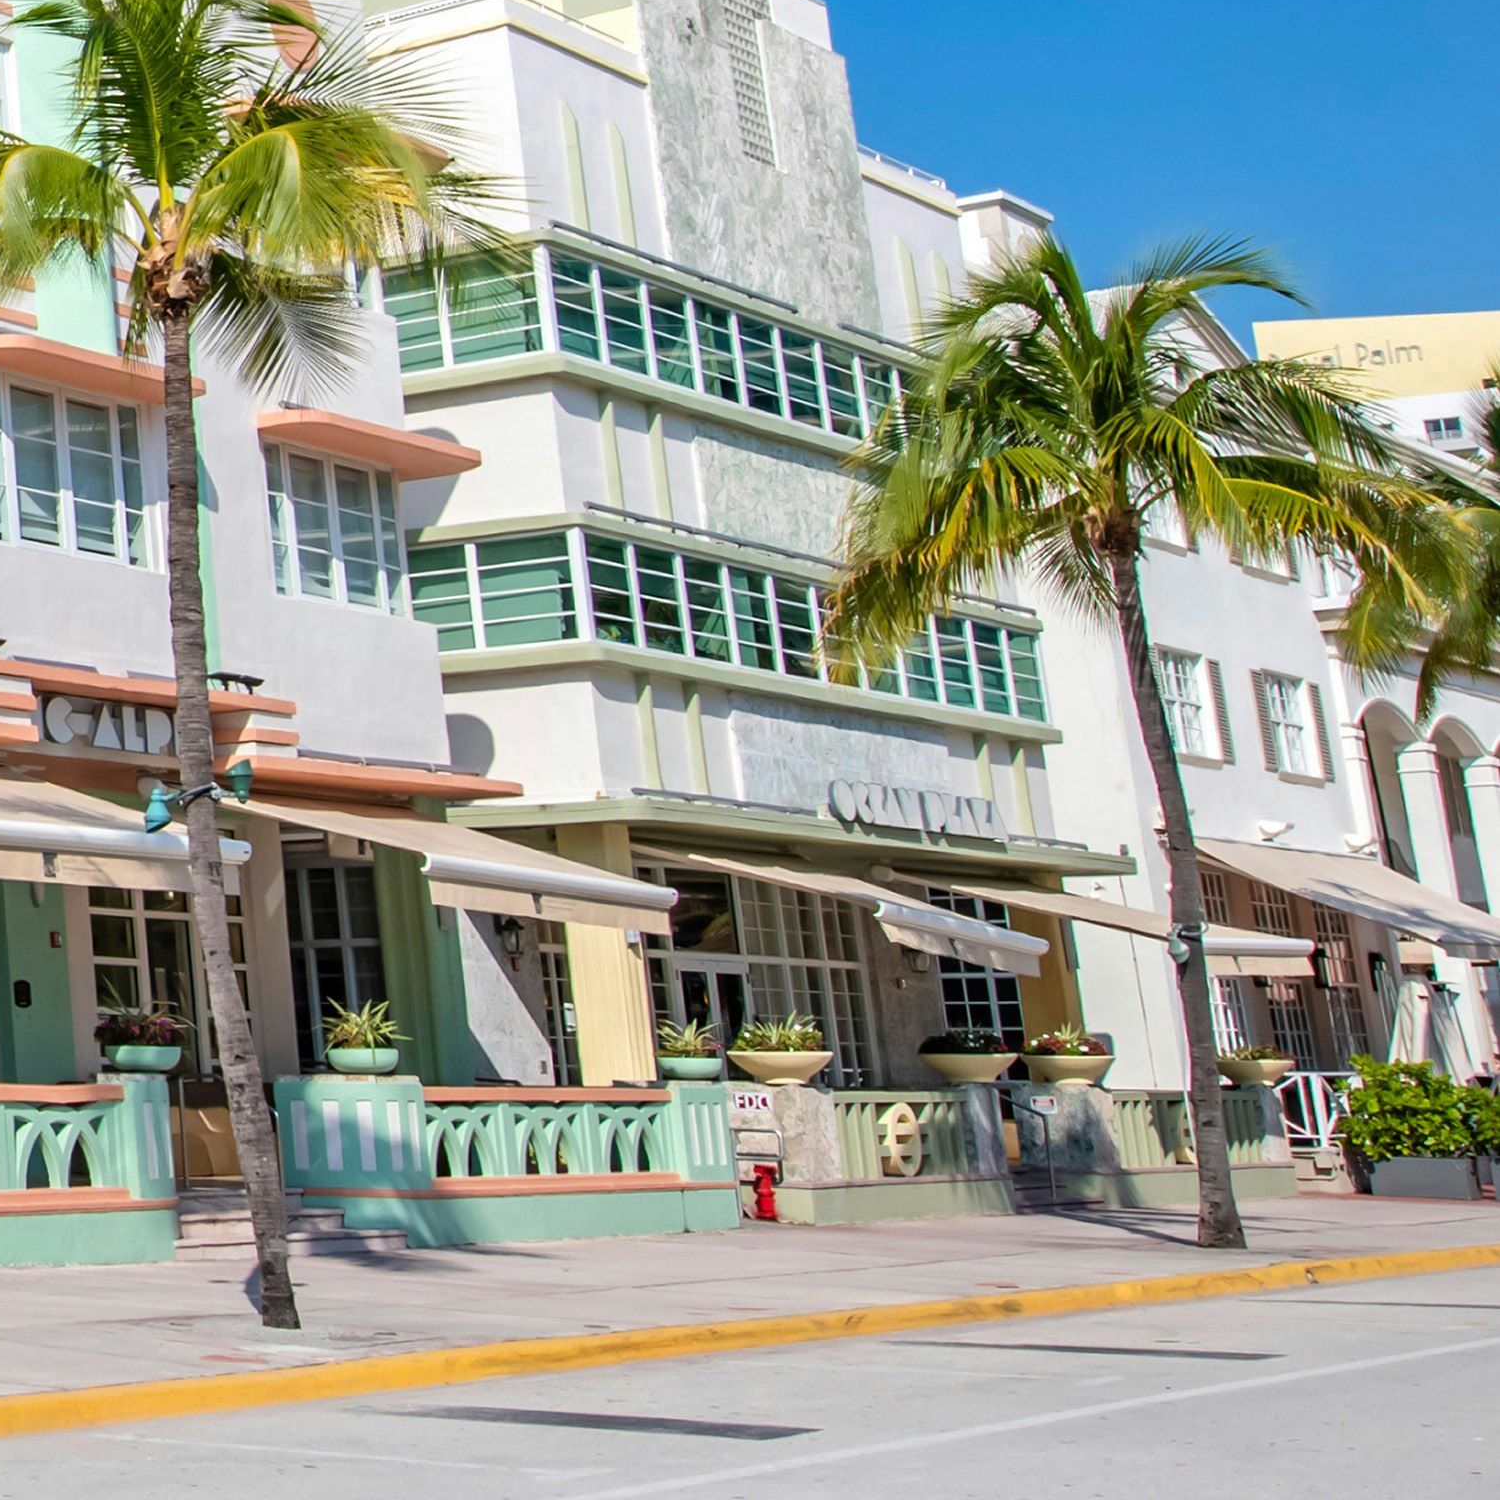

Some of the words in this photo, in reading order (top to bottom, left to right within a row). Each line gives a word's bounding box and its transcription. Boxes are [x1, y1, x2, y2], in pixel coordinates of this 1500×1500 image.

[1355, 339, 1424, 368] Palm
[45, 696, 178, 754] CALP
[827, 777, 925, 831] OCEAN
[734, 1093, 770, 1111] FDC
